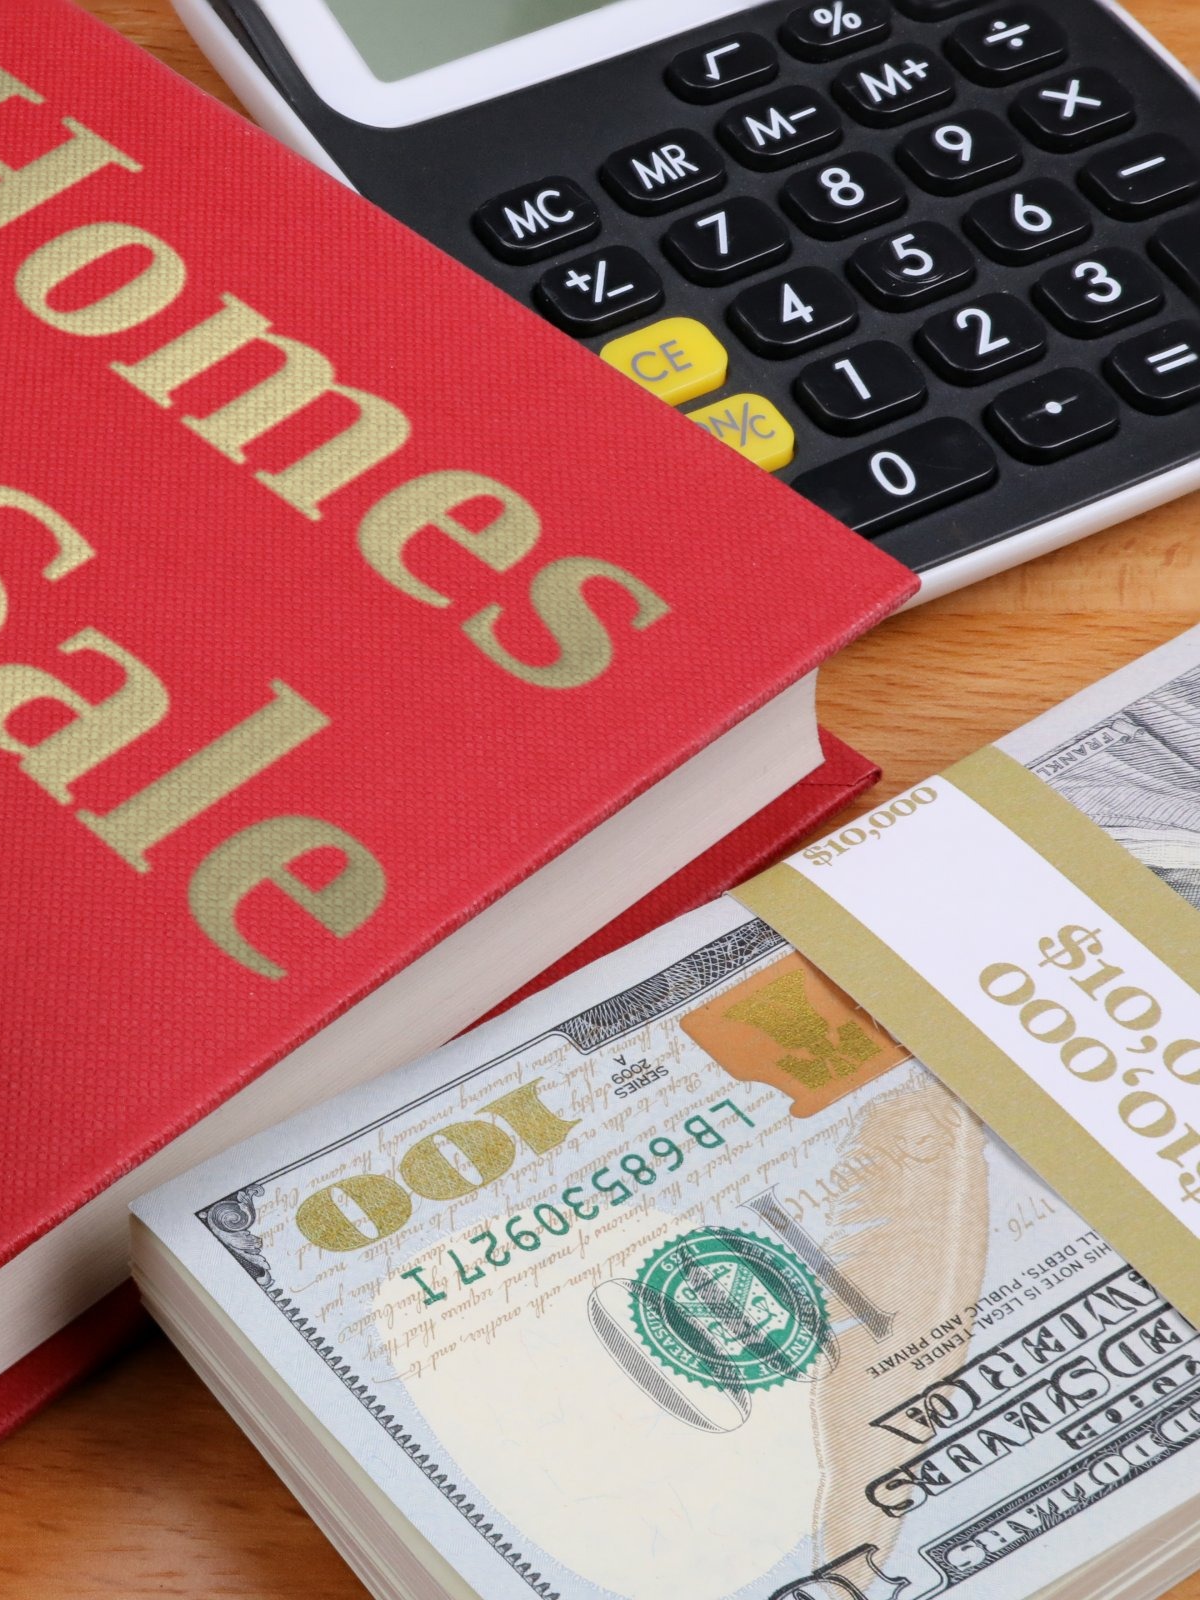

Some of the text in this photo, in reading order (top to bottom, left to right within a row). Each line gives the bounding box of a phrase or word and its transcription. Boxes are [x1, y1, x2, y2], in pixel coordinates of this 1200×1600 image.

[859, 58, 929, 103] M+
[934, 124, 973, 163] 9
[631, 143, 700, 190] MR
[819, 166, 865, 207] 8
[503, 189, 575, 239] MC
[696, 211, 728, 255] 7
[1013, 192, 1053, 233] 6
[891, 233, 934, 277] 5
[781, 282, 814, 324] 4
[1073, 260, 1122, 304] 3
[954, 306, 1010, 357] 2
[630, 339, 693, 382] CE
[832, 357, 872, 400] 1
[868, 449, 917, 496] 0
[1039, 728, 1114, 781] FRANKL
[802, 786, 938, 867] $10,000
[611, 1058, 651, 1084] 2009
[612, 1054, 627, 1066] A
[614, 1063, 669, 1099] SERIES
[296, 1077, 582, 1252] 100
[863, 1231, 1099, 1381] LL DEBTS, PUBLIC AND PRIVATE
[906, 1242, 1112, 1373] HIS NOTE IS LEGAL TENDER
[869, 1266, 1161, 1446] AMERICA
[864, 1354, 1111, 1518] STATES
[942, 1427, 1160, 1574] DOLLARS
